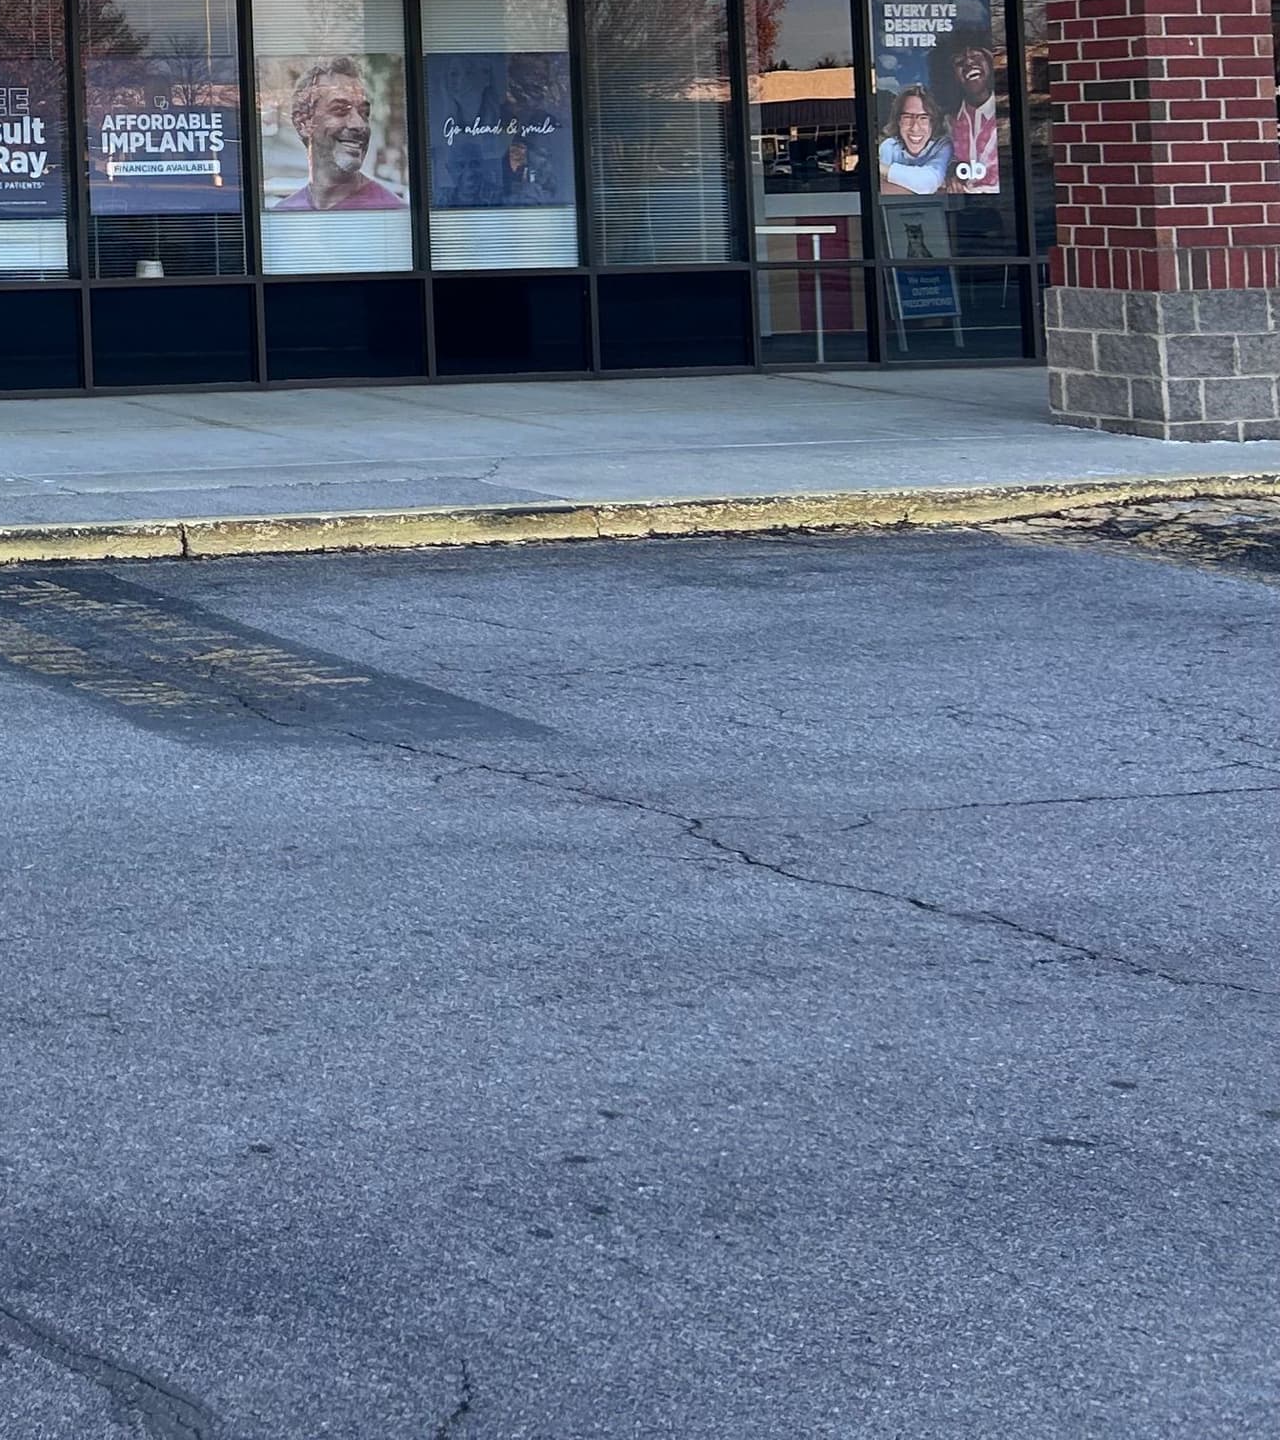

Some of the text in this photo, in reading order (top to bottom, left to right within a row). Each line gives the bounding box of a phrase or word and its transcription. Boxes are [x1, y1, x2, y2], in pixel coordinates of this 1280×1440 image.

[884, 4, 957, 17] EVERY EYE
[885, 19, 953, 33] DESERVES
[885, 34, 937, 47] BETTER
[102, 112, 223, 131] AFFORDABLE
[443, 117, 462, 146] Go
[465, 116, 502, 136] ahead
[506, 118, 518, 135] &
[101, 130, 225, 153] IMPLANTS
[114, 163, 214, 173] FINANCING AVAILABLE
